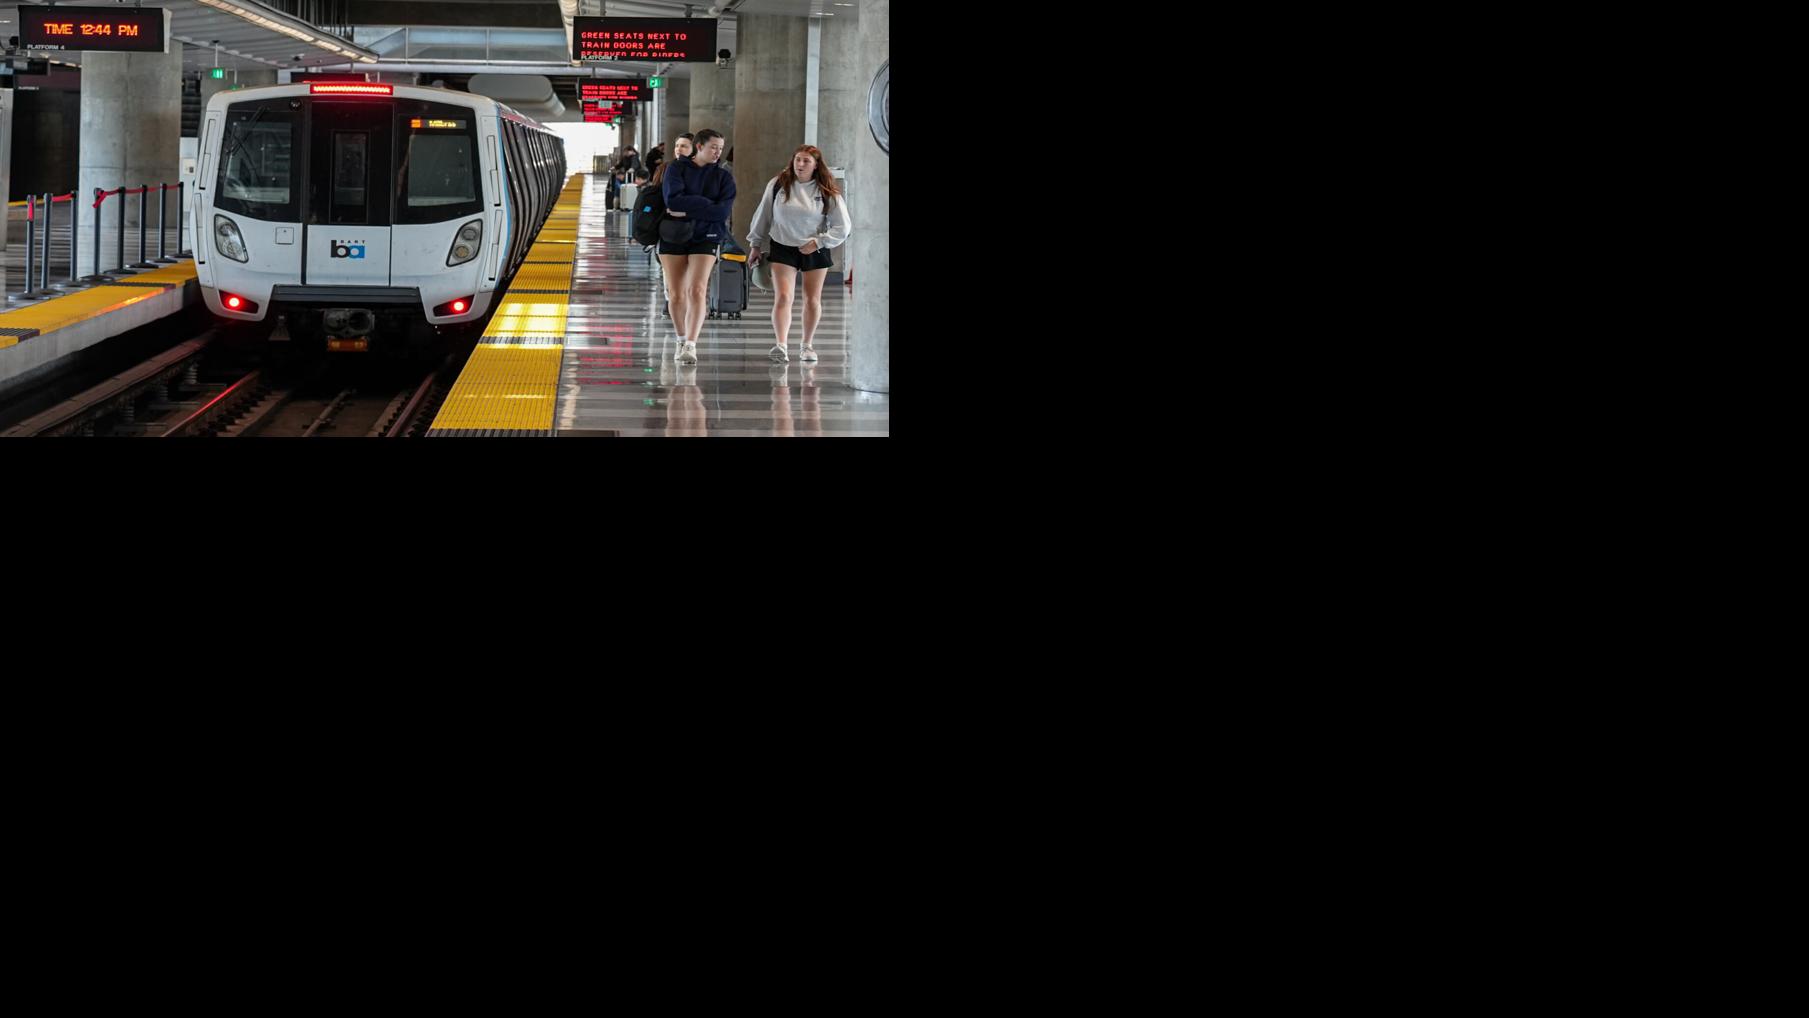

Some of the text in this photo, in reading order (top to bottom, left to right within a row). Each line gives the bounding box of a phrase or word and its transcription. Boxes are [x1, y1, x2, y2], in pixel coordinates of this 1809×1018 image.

[44, 23, 138, 36] TIME 12:44 PM
[581, 31, 610, 40] GREEN
[613, 32, 644, 40] SEATS
[581, 41, 610, 49] TRAIN
[647, 42, 666, 50] ARE
